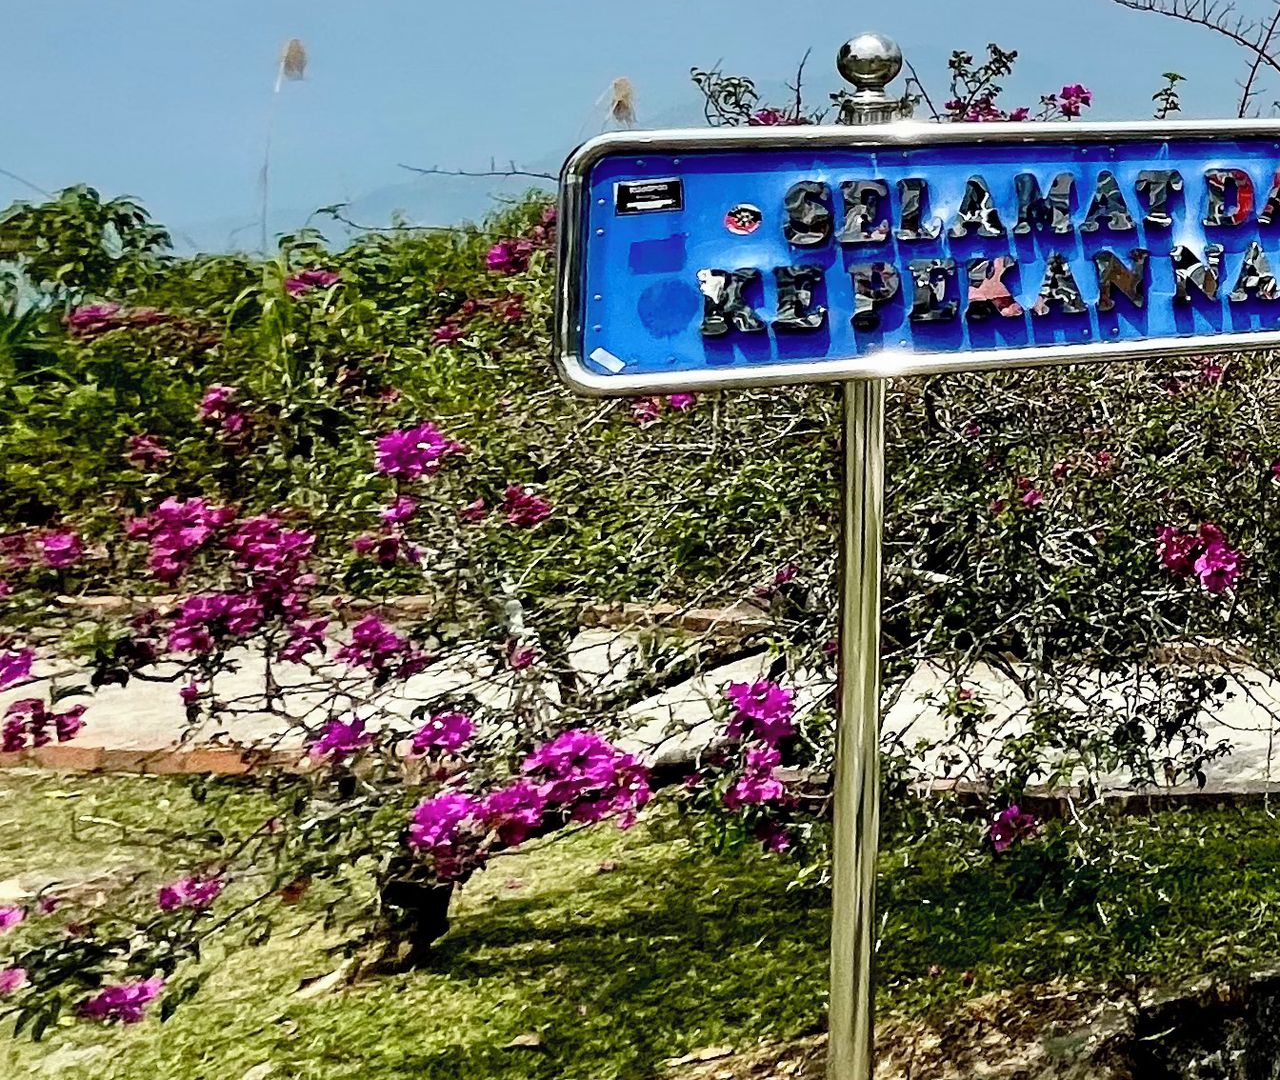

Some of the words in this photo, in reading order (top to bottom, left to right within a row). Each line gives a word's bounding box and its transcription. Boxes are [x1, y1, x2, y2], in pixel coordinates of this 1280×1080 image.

[783, 170, 1183, 243] SELAMAT
[697, 266, 827, 333] KE
[851, 249, 1148, 331] PEKAN
